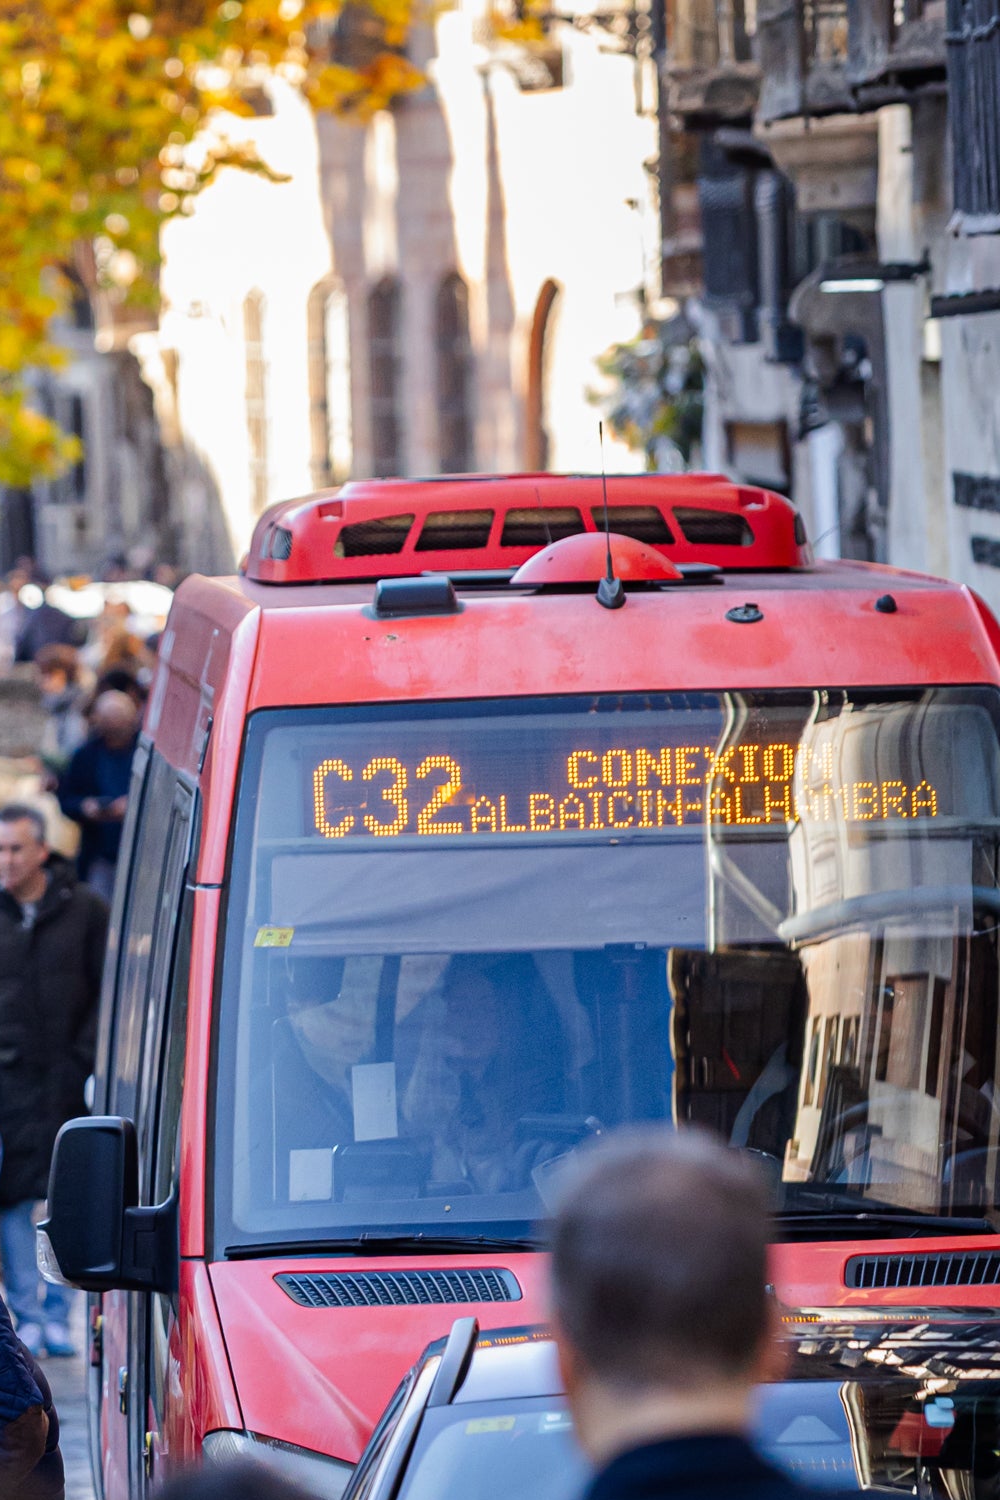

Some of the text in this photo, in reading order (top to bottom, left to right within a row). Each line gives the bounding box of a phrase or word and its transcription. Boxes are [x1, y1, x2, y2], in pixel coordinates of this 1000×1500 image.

[567, 743, 832, 788] CONEXION
[313, 755, 463, 838] C32
[471, 780, 937, 833] ALBAICIN-ALHAMBRA
